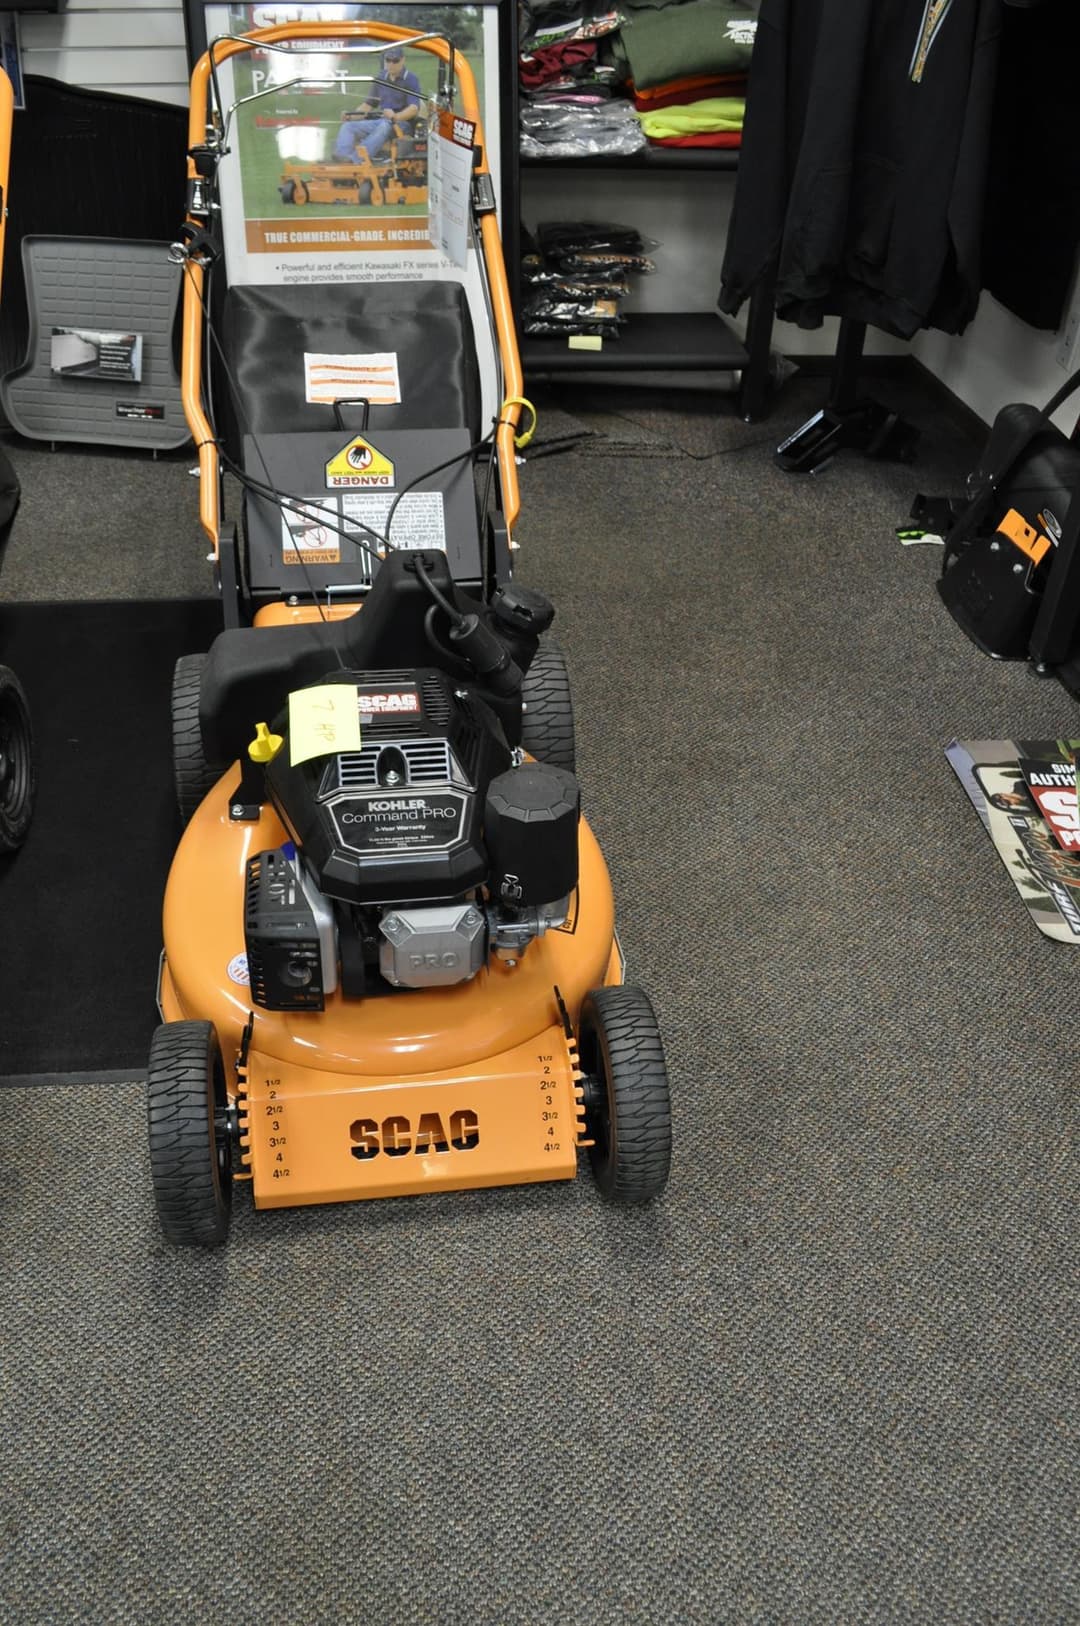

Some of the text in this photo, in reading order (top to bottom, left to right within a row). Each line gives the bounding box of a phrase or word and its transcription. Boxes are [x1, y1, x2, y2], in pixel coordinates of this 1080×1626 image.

[265, 233, 288, 244] TRUE
[387, 230, 430, 241] INCREDIB
[281, 263, 316, 272] Powerful
[317, 263, 332, 271] and
[333, 262, 363, 271] efficient
[364, 261, 402, 270] Kawasaki
[403, 261, 414, 269] FX
[283, 271, 423, 283] engine provides smooth performance
[332, 476, 389, 485] DANGER
[285, 555, 330, 563] WARNNG
[358, 693, 417, 708] SCAG
[368, 799, 426, 812] KOHLER
[341, 807, 456, 824] Command PRO
[408, 951, 460, 972] PRO
[543, 1065, 551, 1074] 2
[269, 1090, 277, 1100] 2
[545, 1095, 553, 1105] 3
[272, 1121, 280, 1131] 3
[546, 1126, 555, 1136] 4
[349, 1109, 481, 1161] SCAG
[275, 1152, 284, 1162] 4
